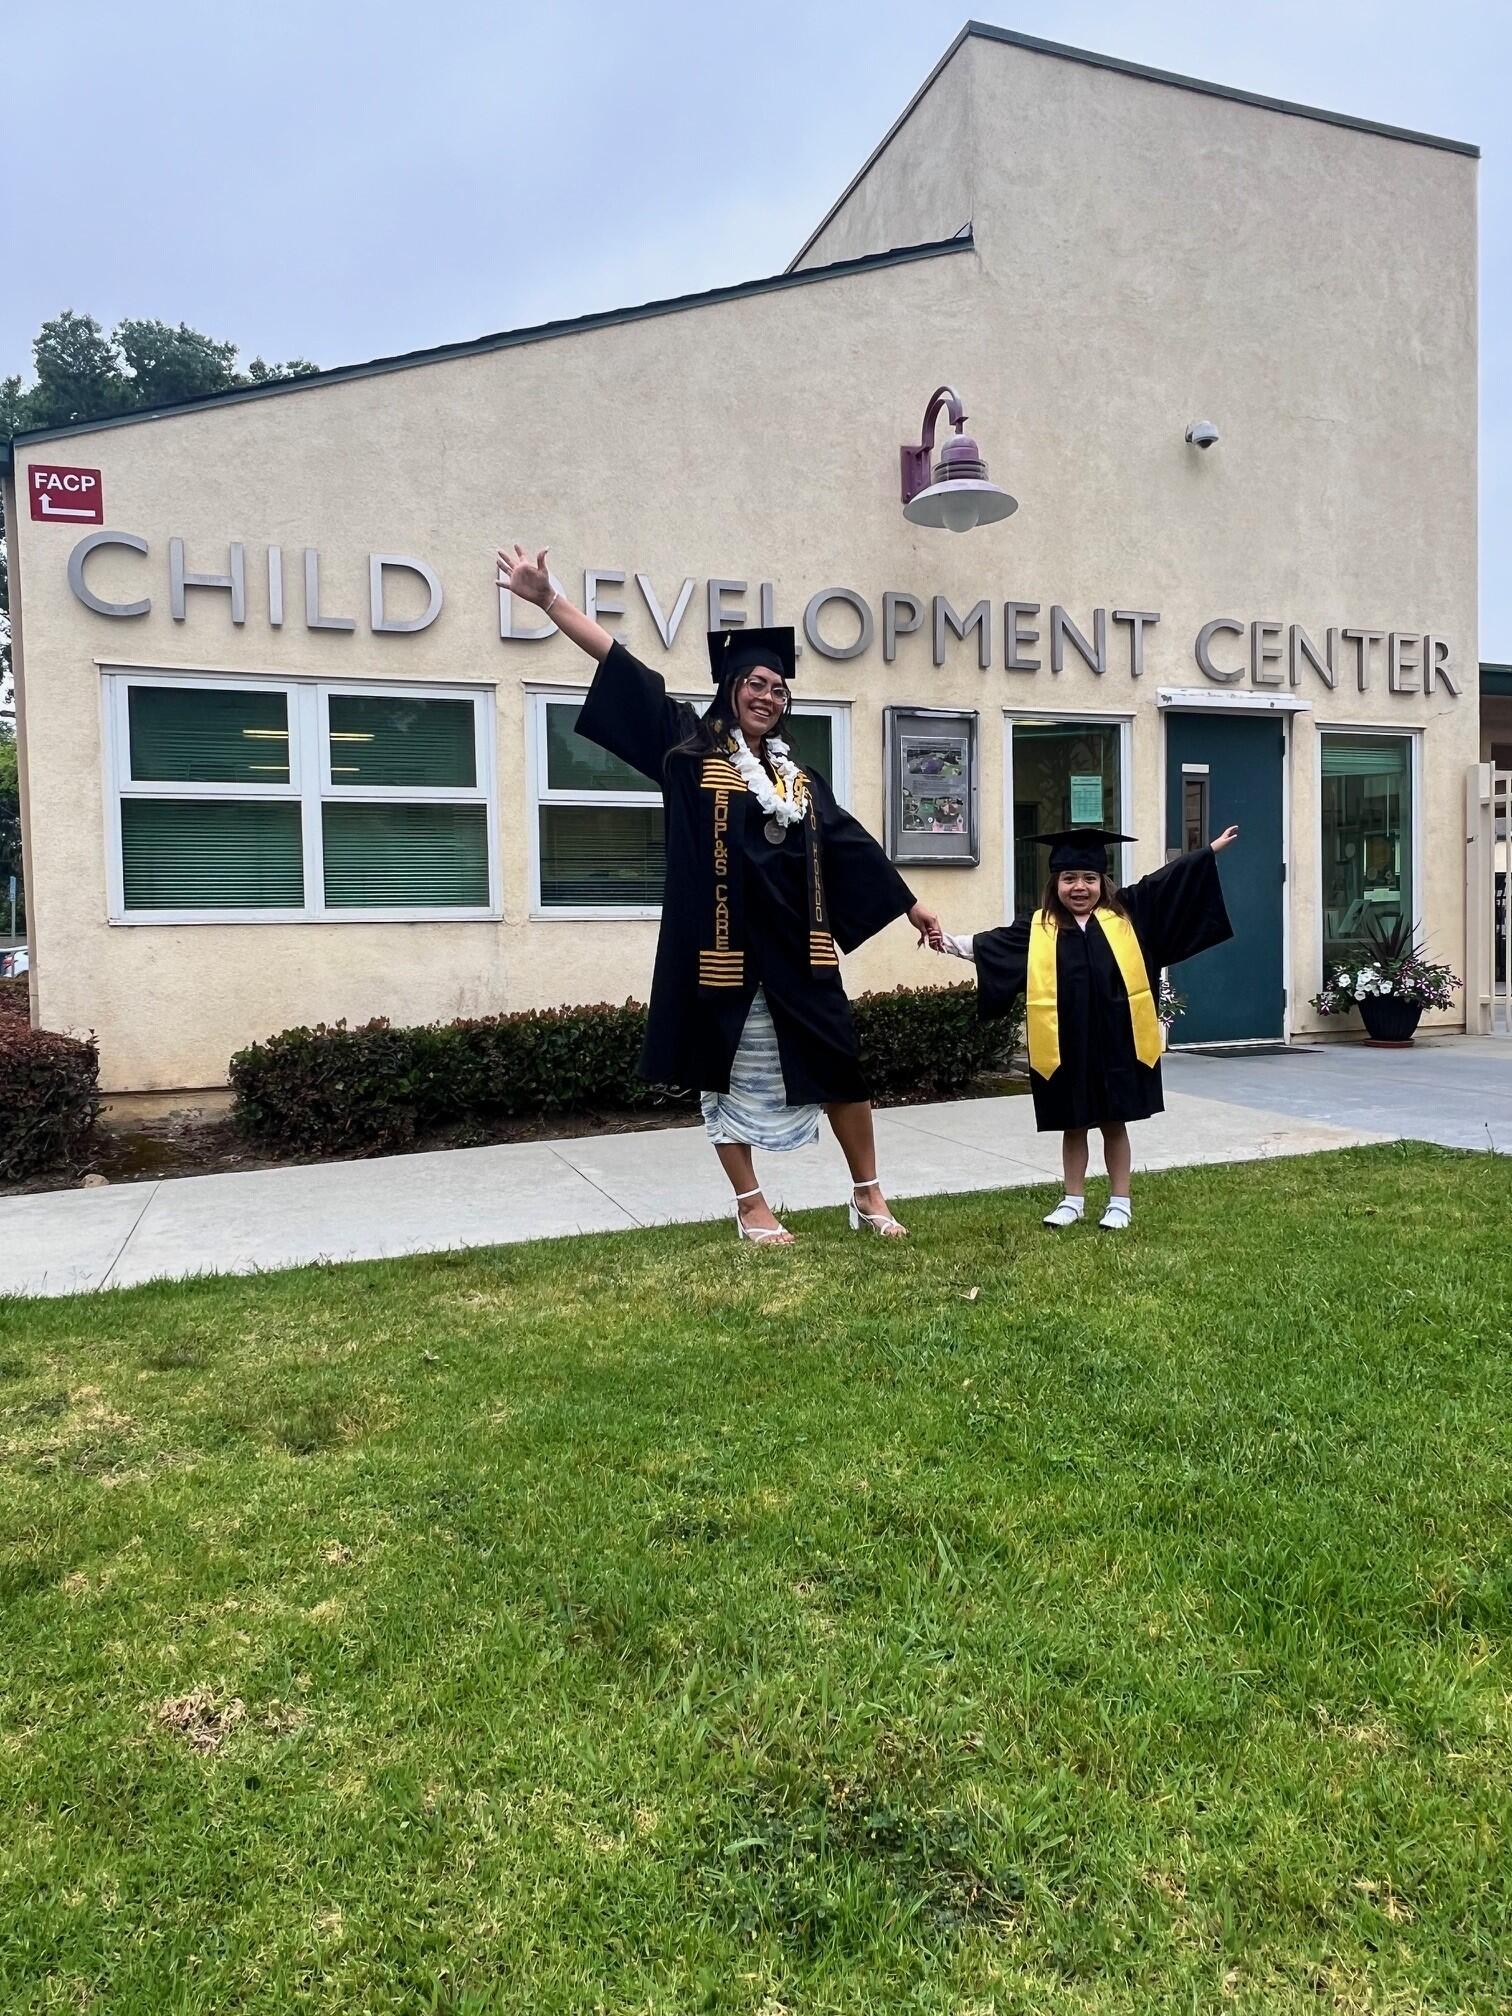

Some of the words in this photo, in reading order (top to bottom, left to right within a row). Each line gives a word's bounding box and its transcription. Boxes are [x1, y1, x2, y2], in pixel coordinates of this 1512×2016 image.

[33, 471, 96, 493] FACP
[67, 530, 443, 632] CHILD
[1195, 617, 1463, 695] CENTER
[714, 789, 729, 876] EOP&S
[715, 884, 729, 950] CARE
